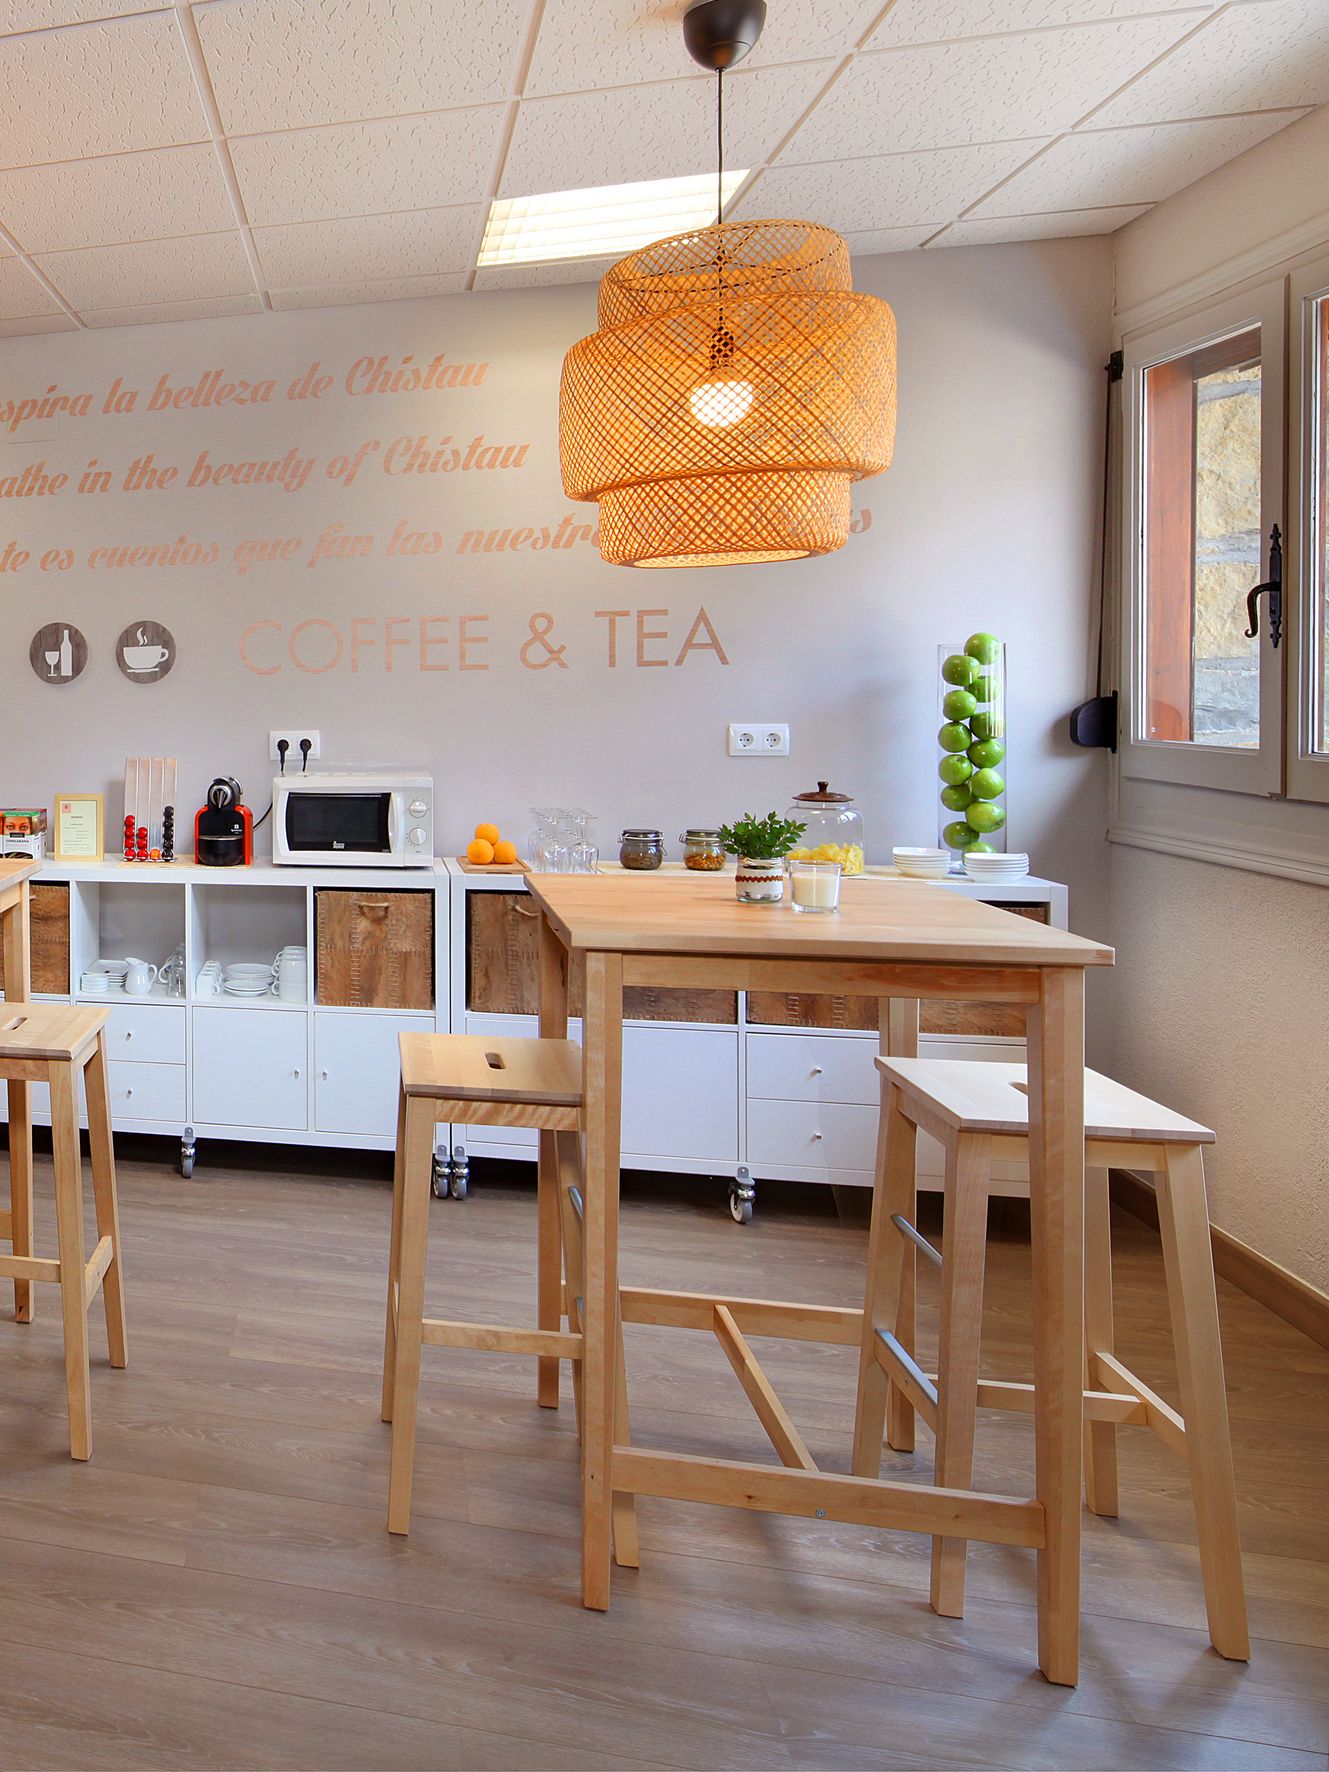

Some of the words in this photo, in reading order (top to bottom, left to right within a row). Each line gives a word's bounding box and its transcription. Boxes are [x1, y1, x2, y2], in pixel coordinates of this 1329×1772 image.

[102, 377, 138, 415] la
[146, 369, 277, 412] belleza
[287, 362, 334, 401] de
[345, 353, 490, 396] Chistau
[77, 458, 112, 493] in
[122, 453, 178, 491] the
[186, 447, 316, 492] beauty
[325, 439, 381, 487] of
[383, 434, 530, 476] Chistau
[40, 546, 75, 571] es
[87, 531, 220, 570] cuentos
[233, 536, 303, 575] que
[306, 522, 374, 569] fan
[385, 517, 443, 556] las
[456, 512, 600, 555] nuestr
[239, 614, 489, 676] COFFEE
[519, 611, 569, 670] &
[594, 606, 730, 667] TEA
